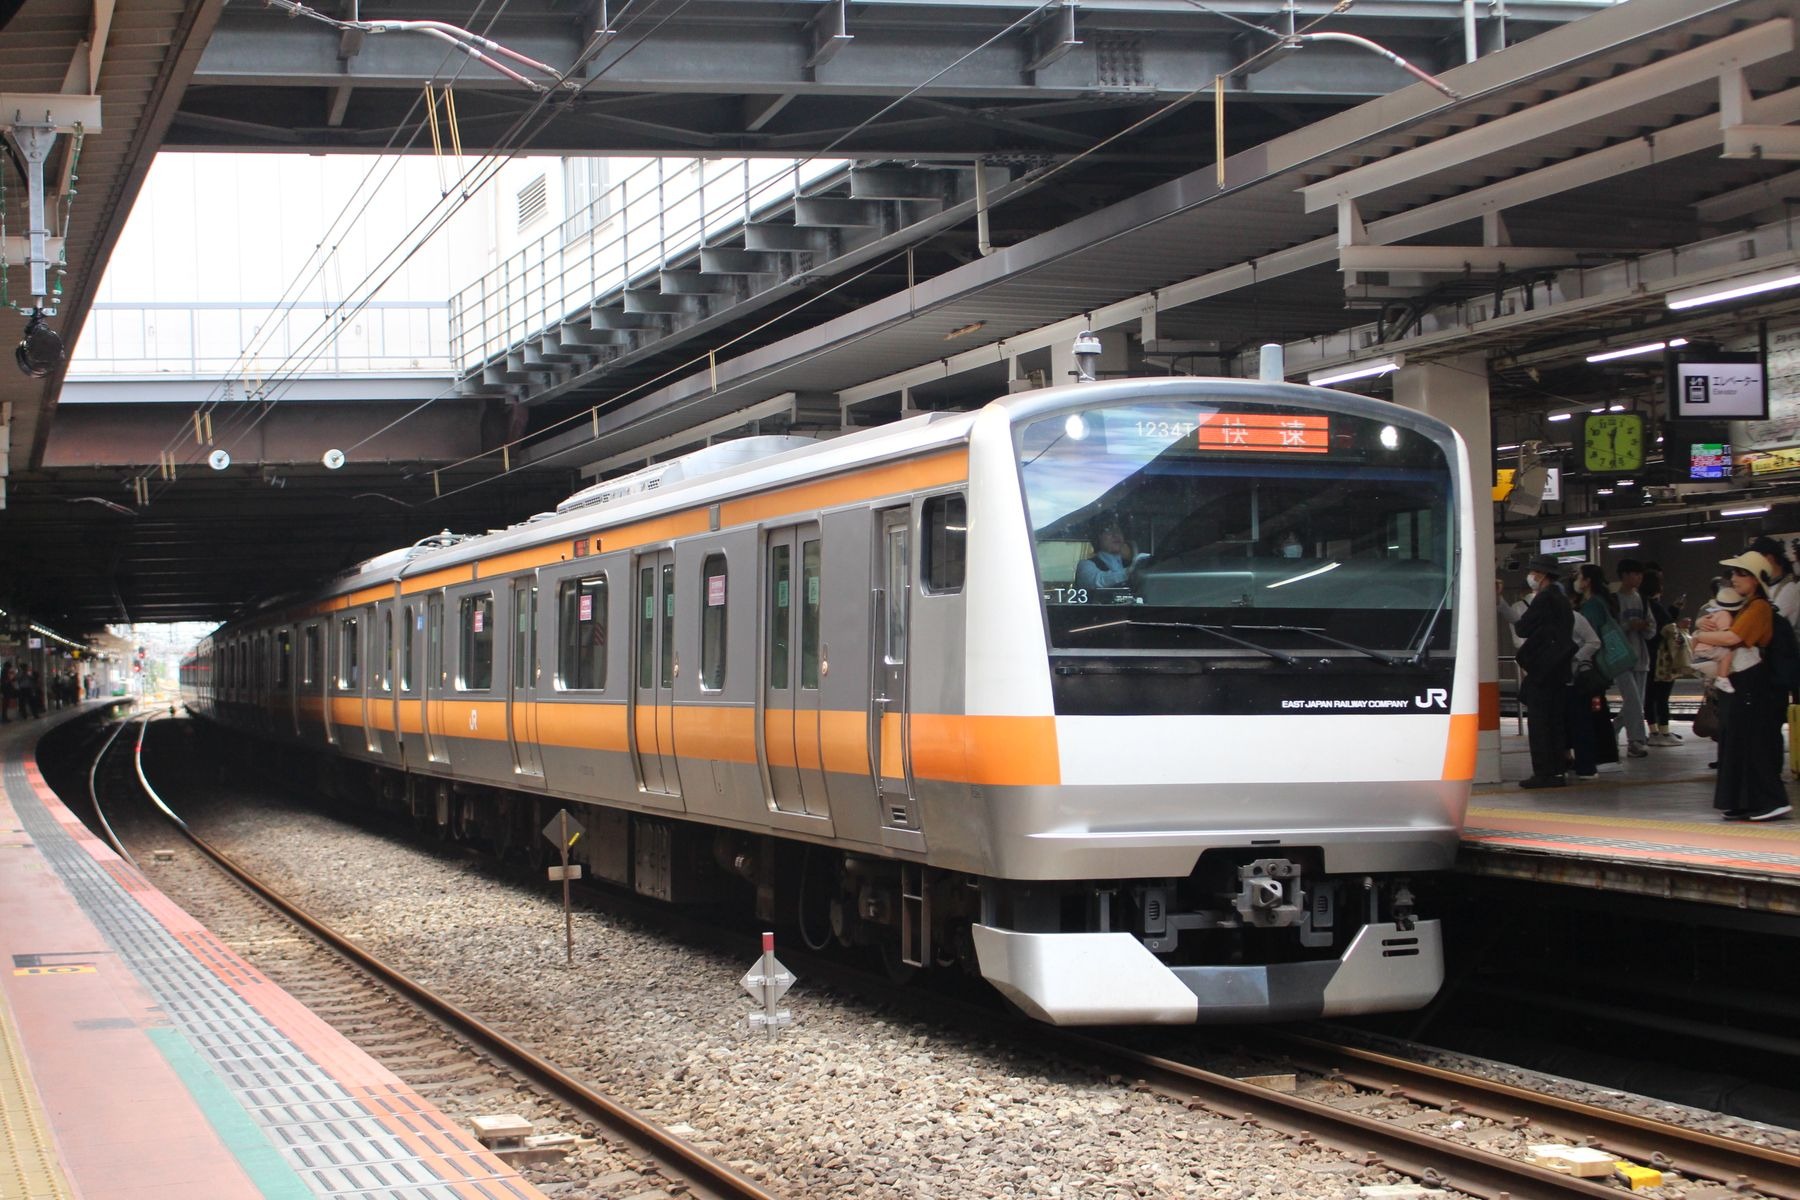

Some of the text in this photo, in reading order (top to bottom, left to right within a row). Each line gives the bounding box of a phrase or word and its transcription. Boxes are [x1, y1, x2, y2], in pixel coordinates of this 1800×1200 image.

[1712, 376, 1760, 388] エレベーター
[1135, 421, 1194, 438] 1234T
[1222, 416, 1307, 449] 快速
[1055, 588, 1089, 604] T23
[1281, 700, 1409, 708] EAST JAPAN RAILWAY COMPANY
[1414, 688, 1448, 708] JR
